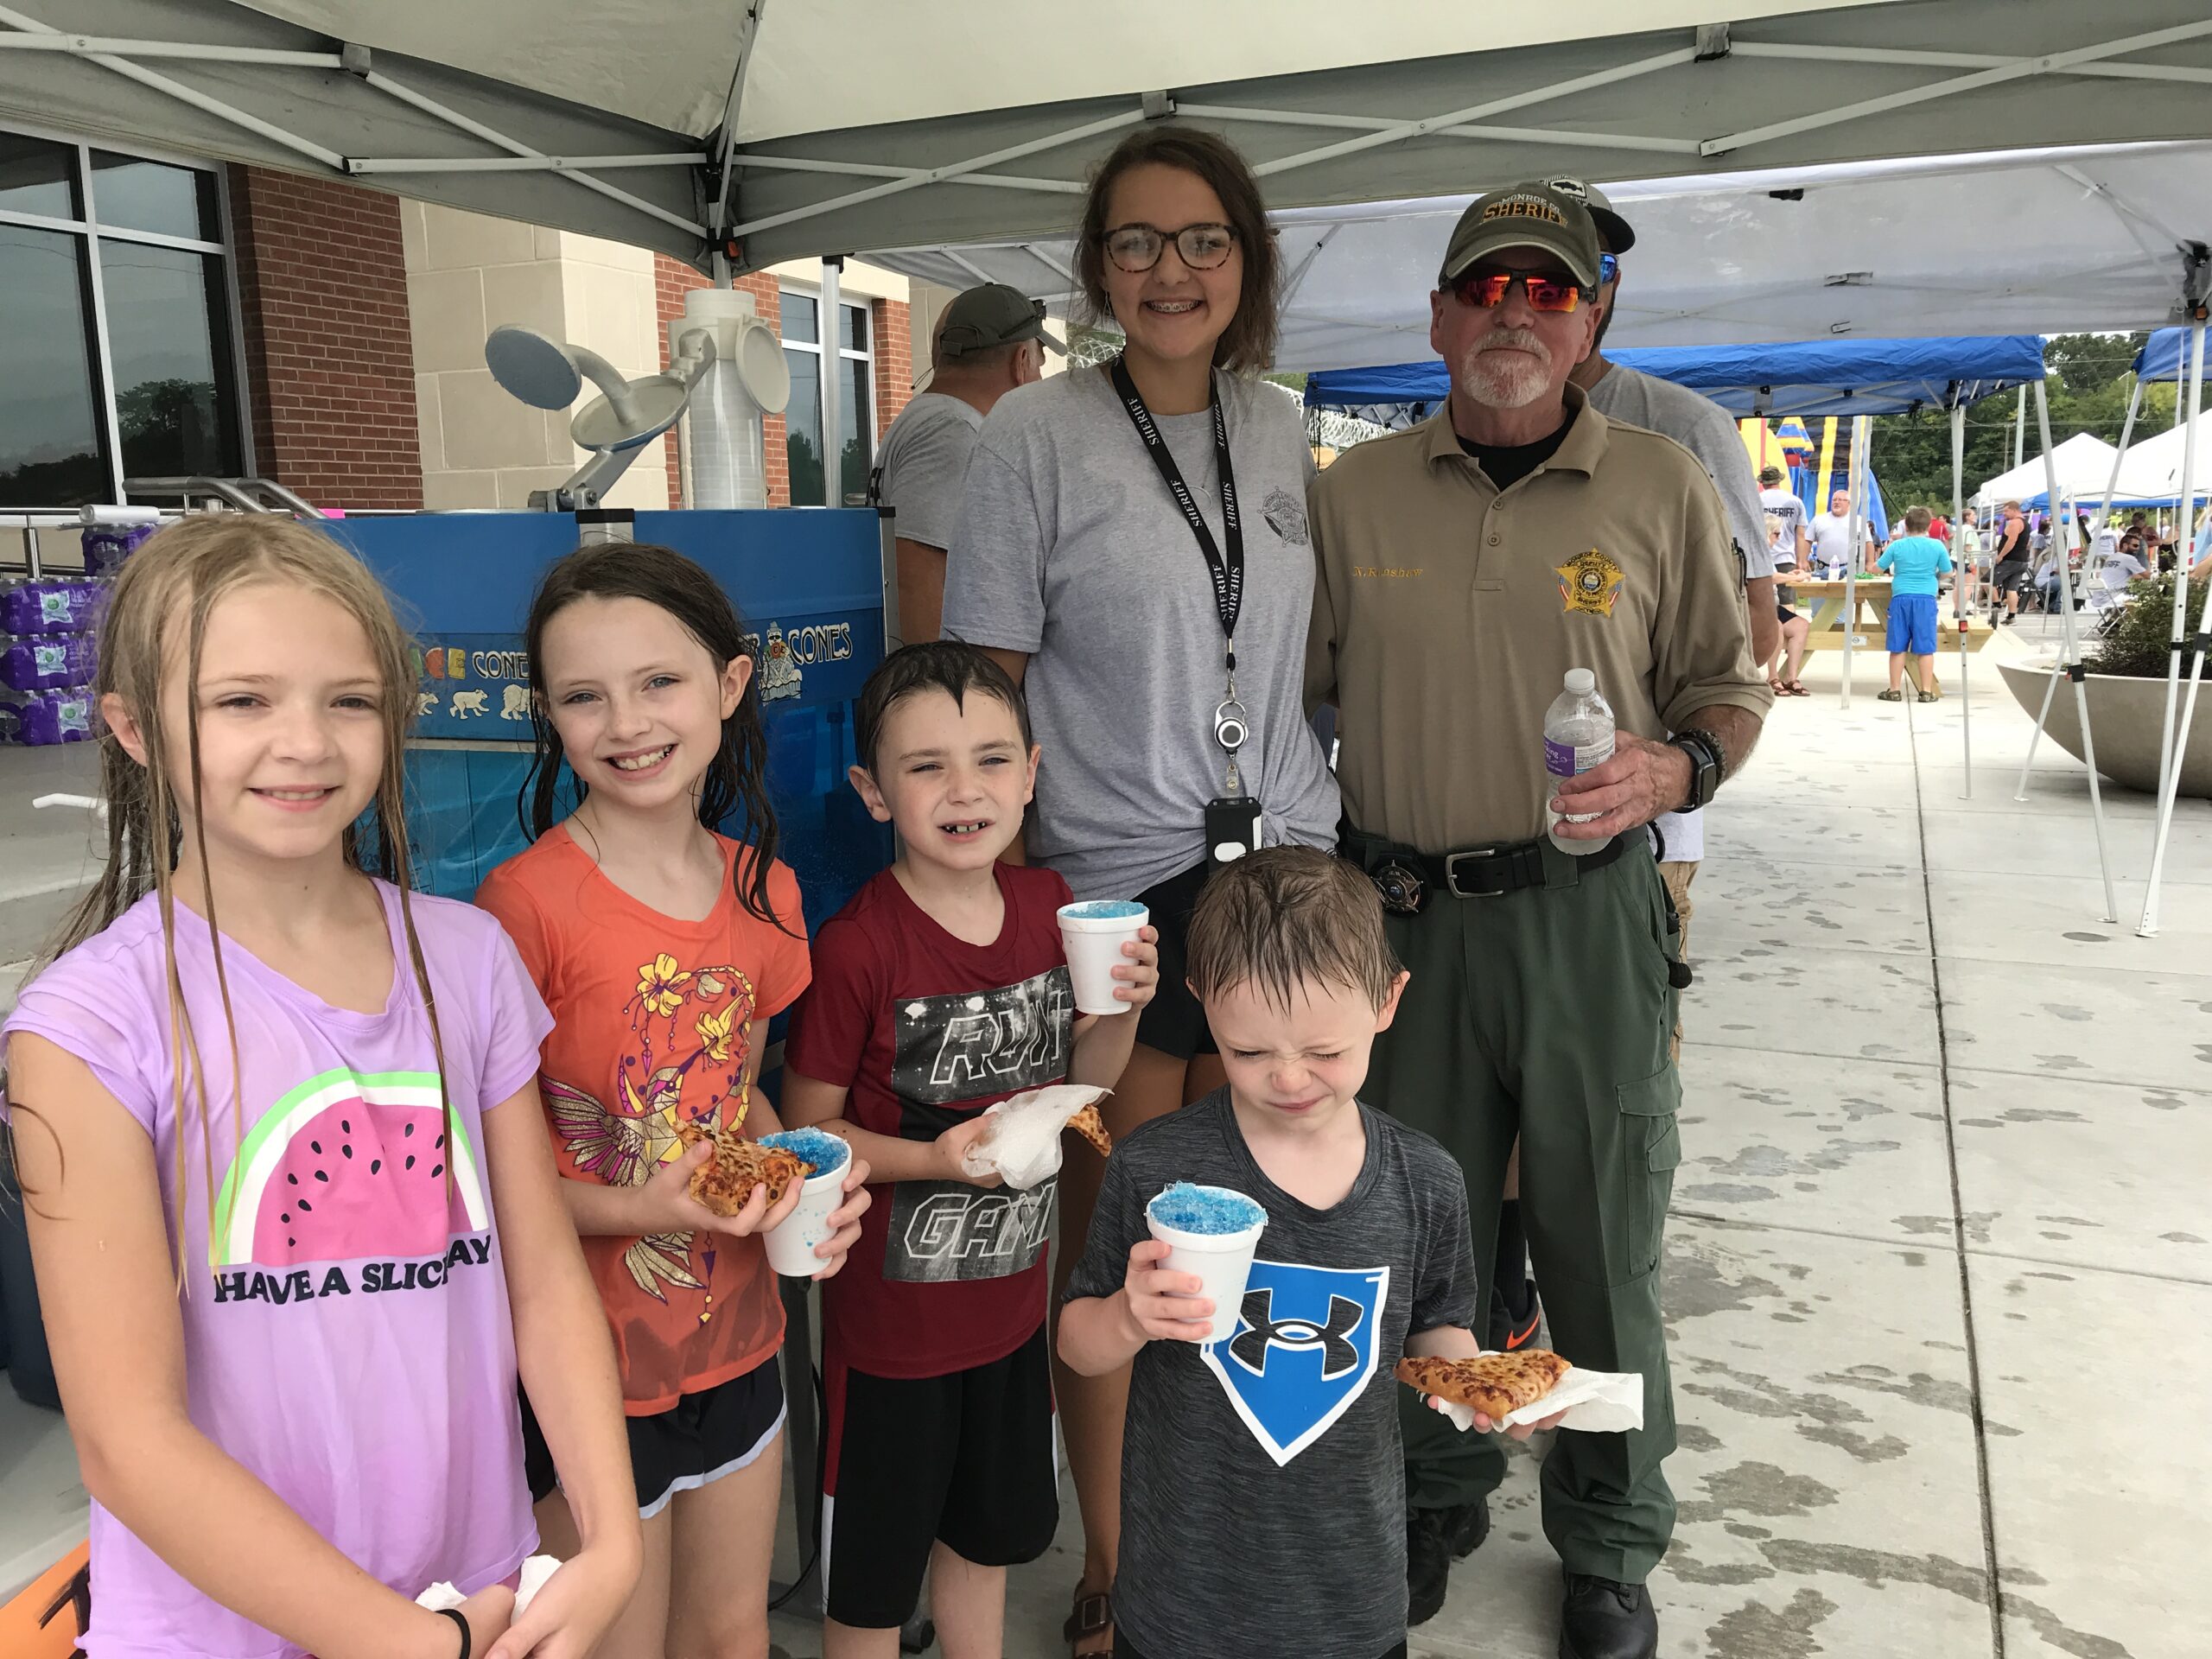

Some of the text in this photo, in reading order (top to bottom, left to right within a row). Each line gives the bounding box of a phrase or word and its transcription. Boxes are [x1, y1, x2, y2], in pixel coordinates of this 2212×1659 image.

[1481, 200, 1569, 228] SHERIFF
[1501, 193, 1548, 205] MONROE
[1127, 397, 1160, 447] SHERIFF
[1170, 479, 1203, 528] SHERIFF
[1222, 480, 1237, 531] SHERIFF
[1212, 563, 1228, 622] SHERIFF
[472, 650, 531, 680] CONE
[787, 621, 853, 666] CONES
[929, 989, 1068, 1085] RUN
[904, 1179, 1058, 1259] GAM
[213, 1269, 315, 1306] HAVE
[318, 1267, 351, 1297] A
[444, 1234, 492, 1270] AY
